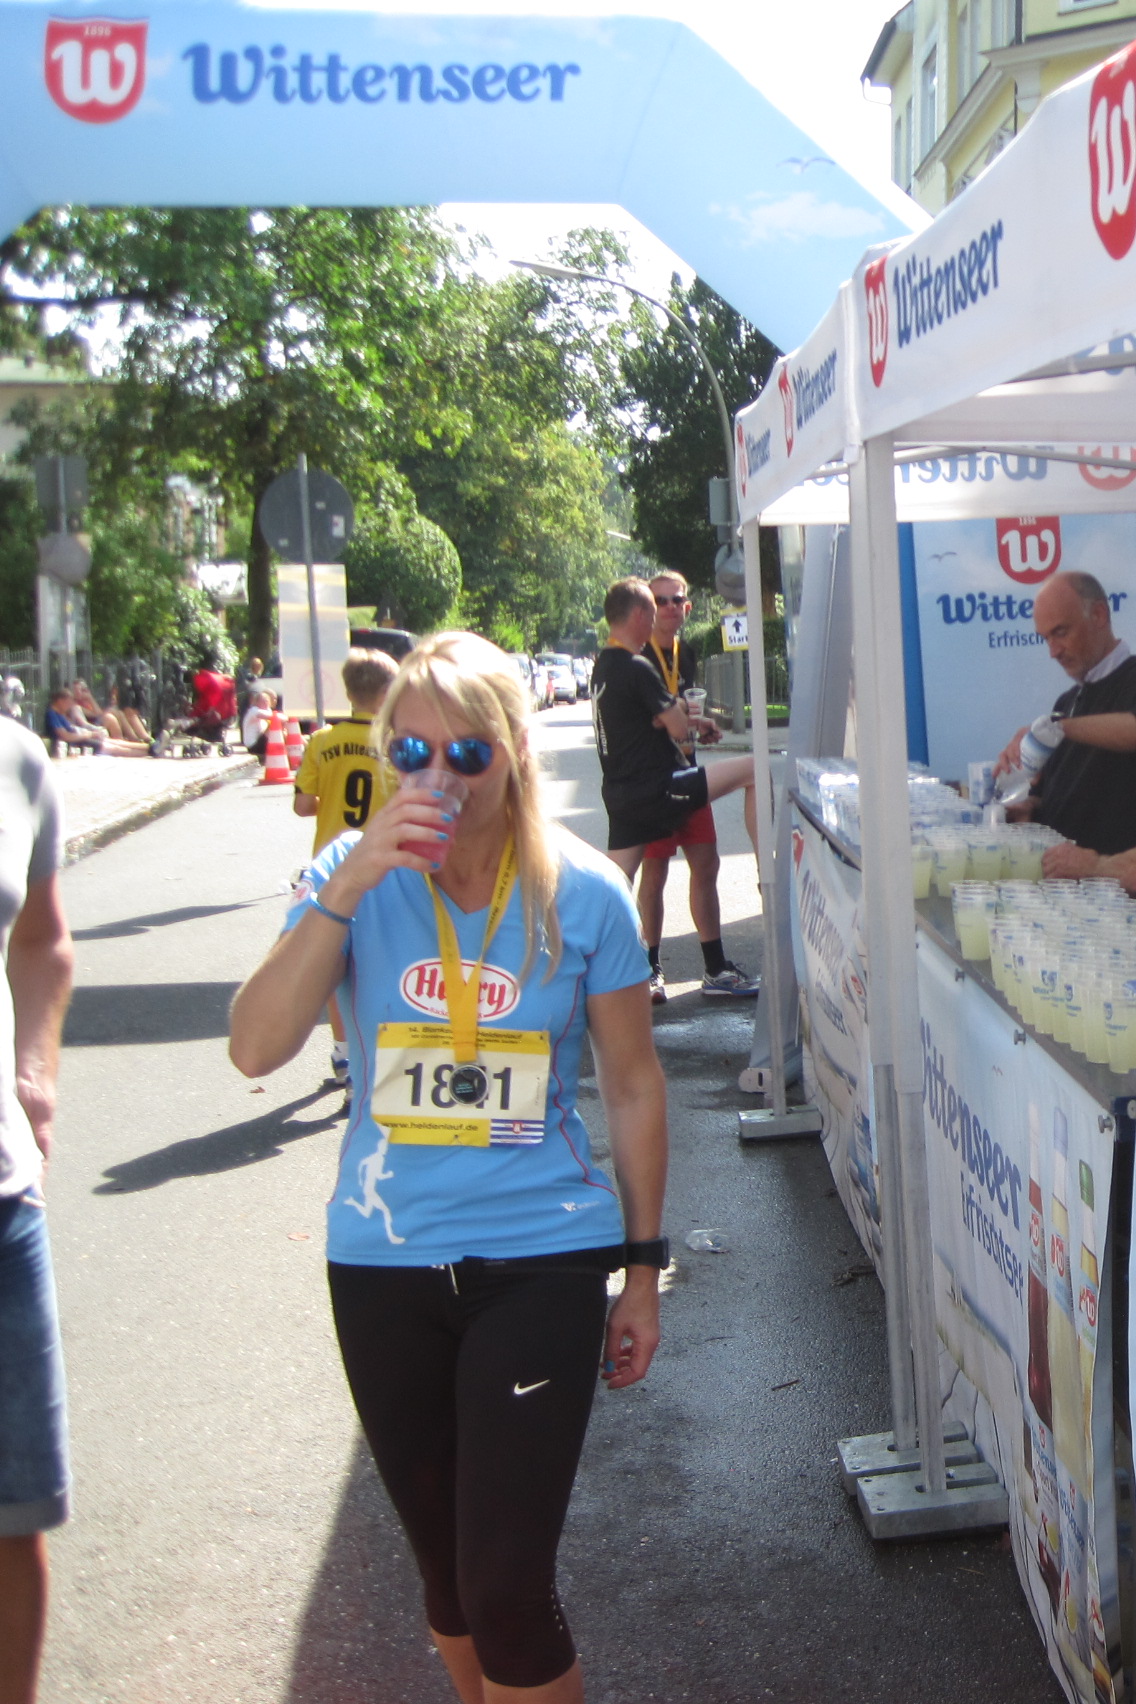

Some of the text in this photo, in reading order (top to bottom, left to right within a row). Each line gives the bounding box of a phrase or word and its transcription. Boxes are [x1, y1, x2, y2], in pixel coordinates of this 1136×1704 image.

[181, 42, 581, 102] Wittenseer
[893, 219, 1004, 348] Wittenseer
[936, 591, 1128, 624] Witter
[988, 630, 1048, 649] Erfrisch
[321, 744, 340, 762] TSV
[343, 769, 373, 828] 9
[404, 1062, 512, 1111] 181
[920, 1017, 1022, 1232] ittenseer
